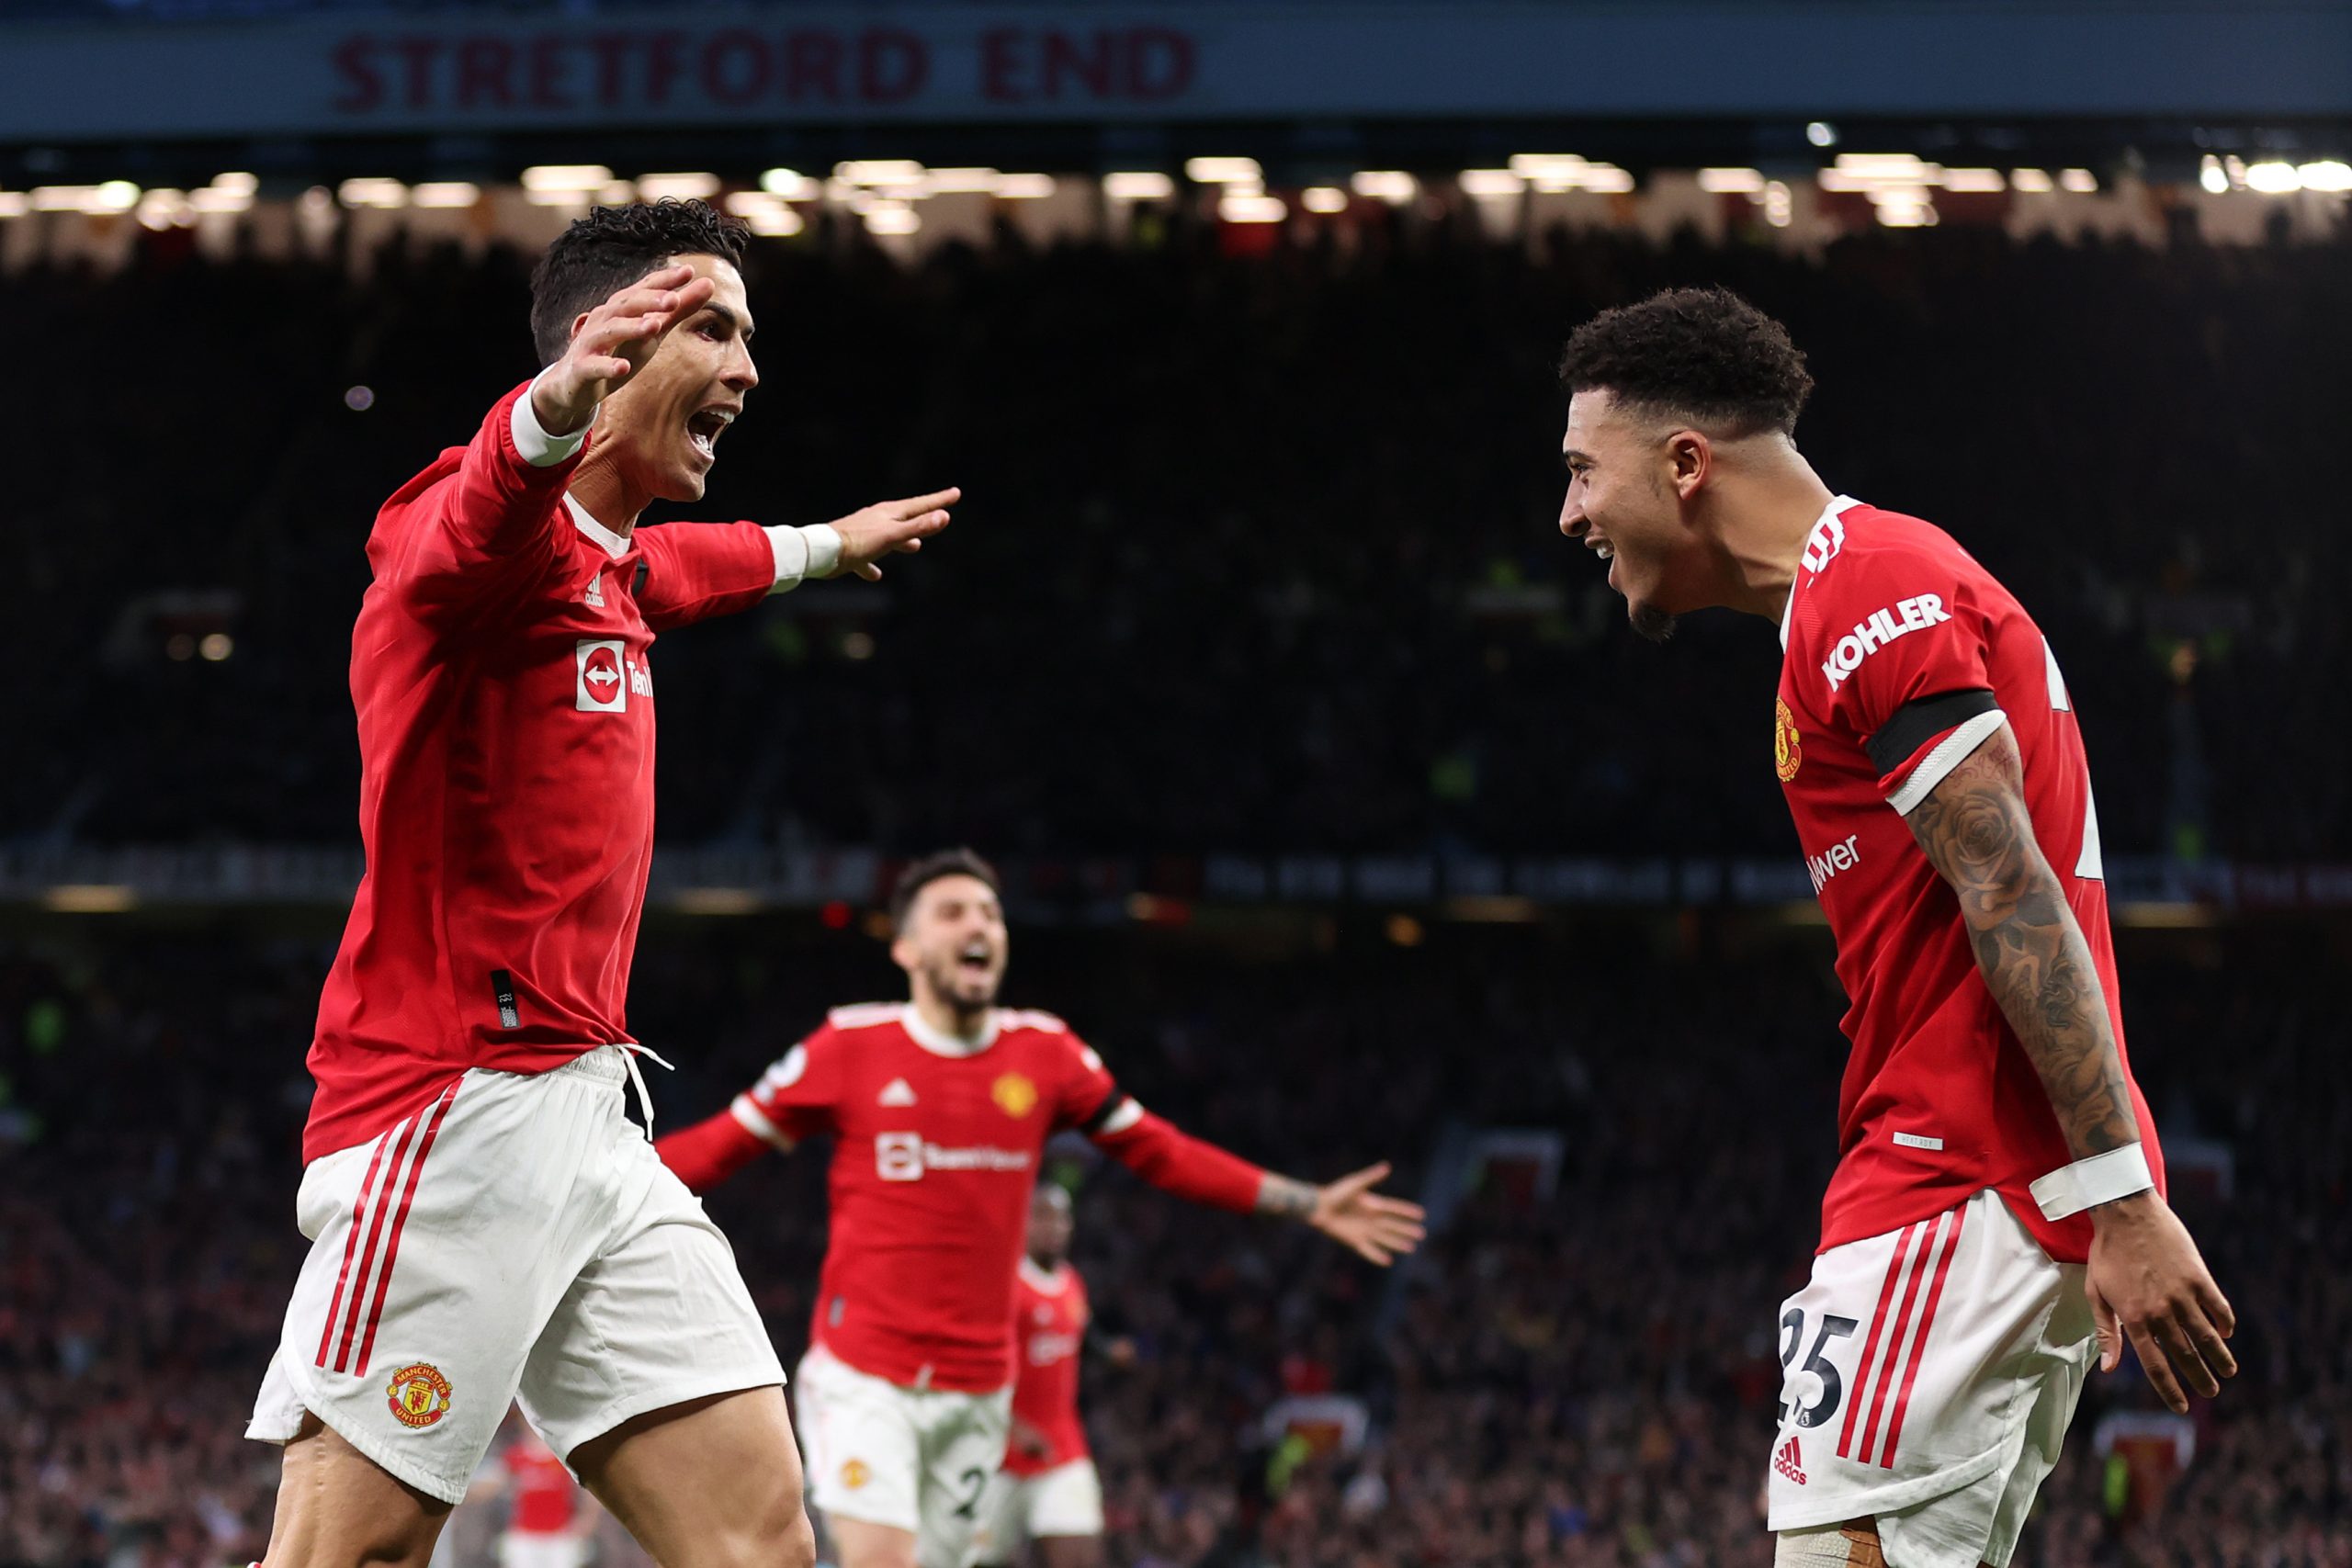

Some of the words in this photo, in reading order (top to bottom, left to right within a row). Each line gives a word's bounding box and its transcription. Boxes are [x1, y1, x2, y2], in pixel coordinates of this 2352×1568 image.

[330, 30, 928, 112] STRETFORD
[981, 25, 1197, 103] END
[1822, 593, 1951, 692] KOHLER
[397, 1367, 447, 1395] MANCHESTER
[1778, 1308, 1860, 1428] 25
[396, 1407, 432, 1424] UNITED
[1774, 1456, 1807, 1485] adidas
